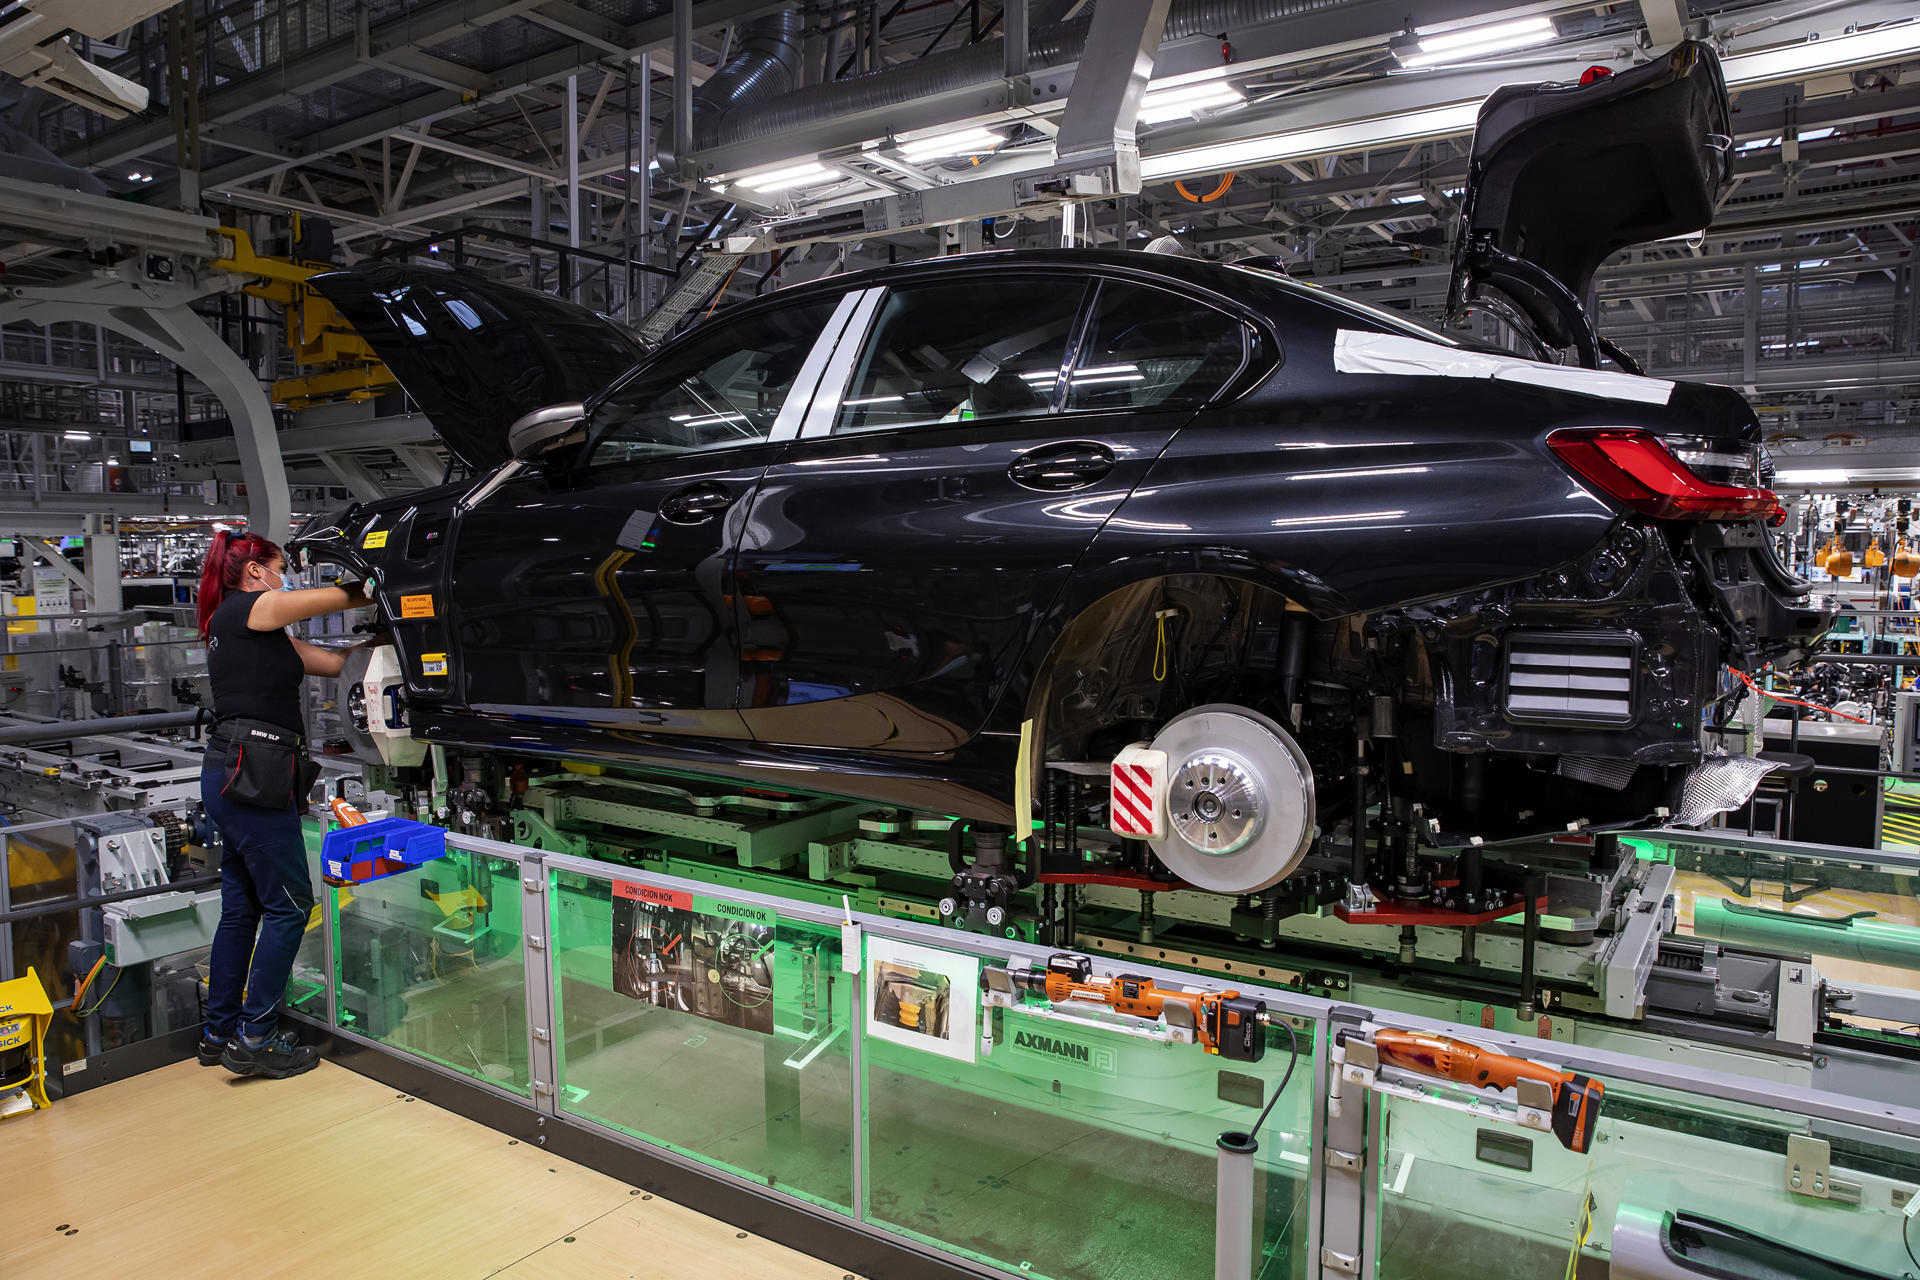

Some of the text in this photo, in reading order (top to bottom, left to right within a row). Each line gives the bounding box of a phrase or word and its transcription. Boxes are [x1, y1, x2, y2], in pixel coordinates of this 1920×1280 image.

[250, 729, 280, 741] BMW SLP
[625, 885, 673, 902] CONDICION NOK
[717, 903, 767, 921] CONDICION OK
[1014, 1031, 1089, 1062] AXMANN
